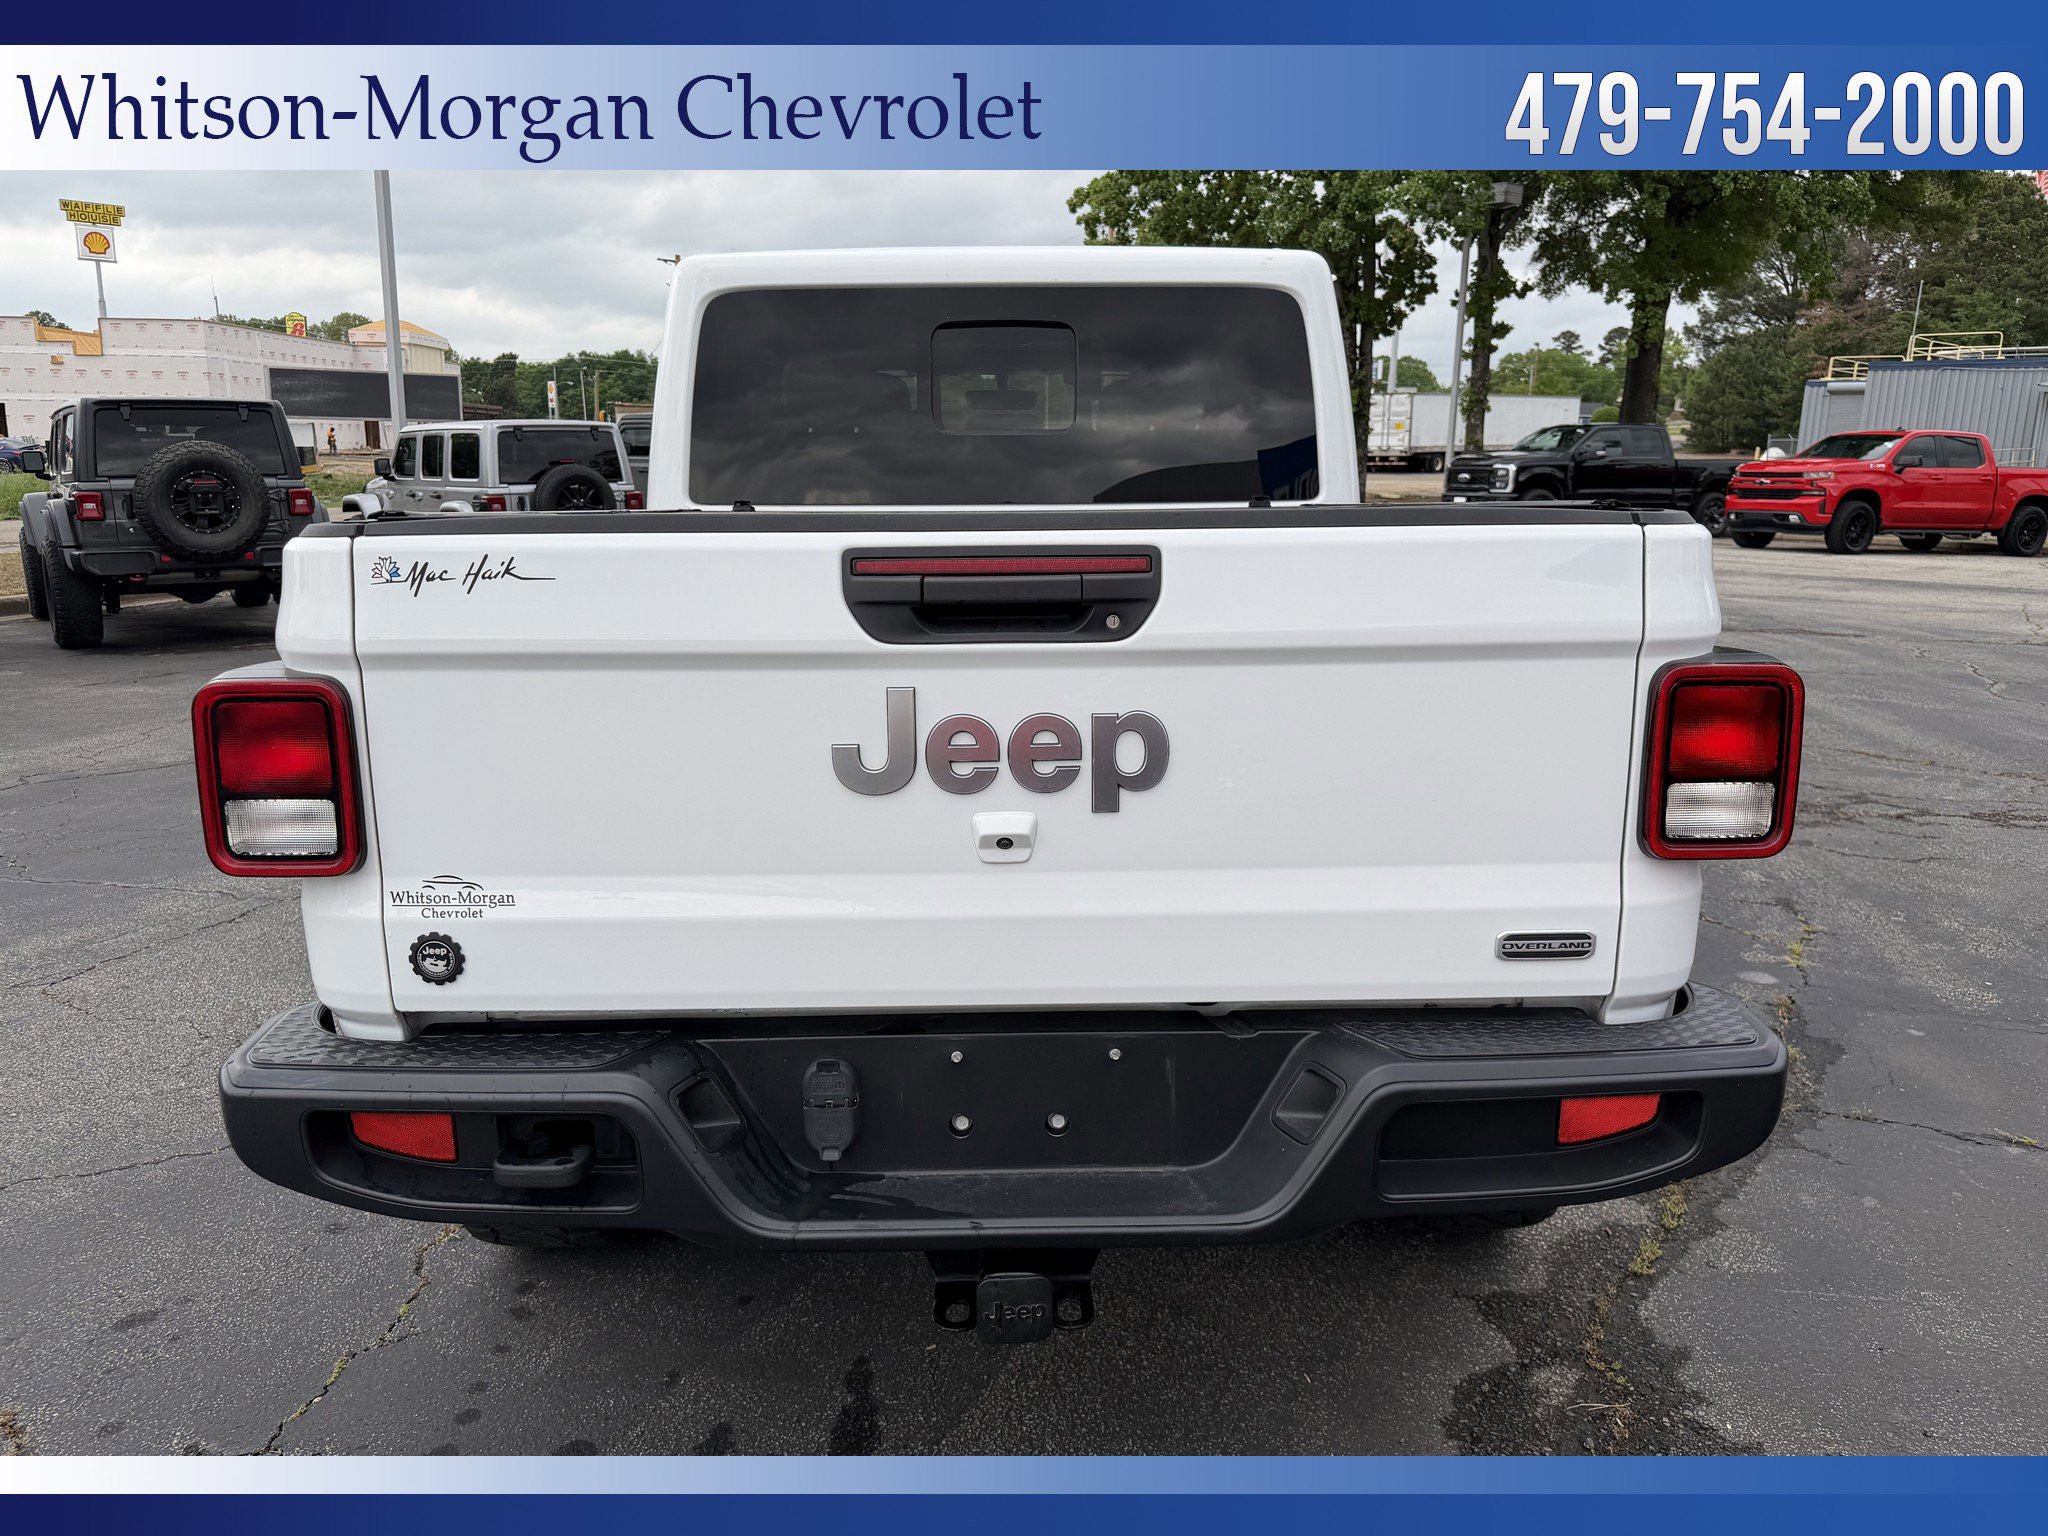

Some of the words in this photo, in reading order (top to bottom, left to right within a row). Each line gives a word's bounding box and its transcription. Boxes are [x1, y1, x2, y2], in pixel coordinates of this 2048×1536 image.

[61, 201, 123, 215] WAFFLE
[69, 212, 119, 224] HOUSE
[404, 561, 456, 598] Mac
[462, 553, 556, 595] Haik
[831, 686, 1170, 813] Jeep
[390, 890, 516, 908] Whitson-Morgan
[421, 907, 484, 919] Chevrolet
[422, 946, 448, 956] Jeep
[1501, 941, 1592, 950] OVERLAND
[982, 1301, 1048, 1323] Jeep
